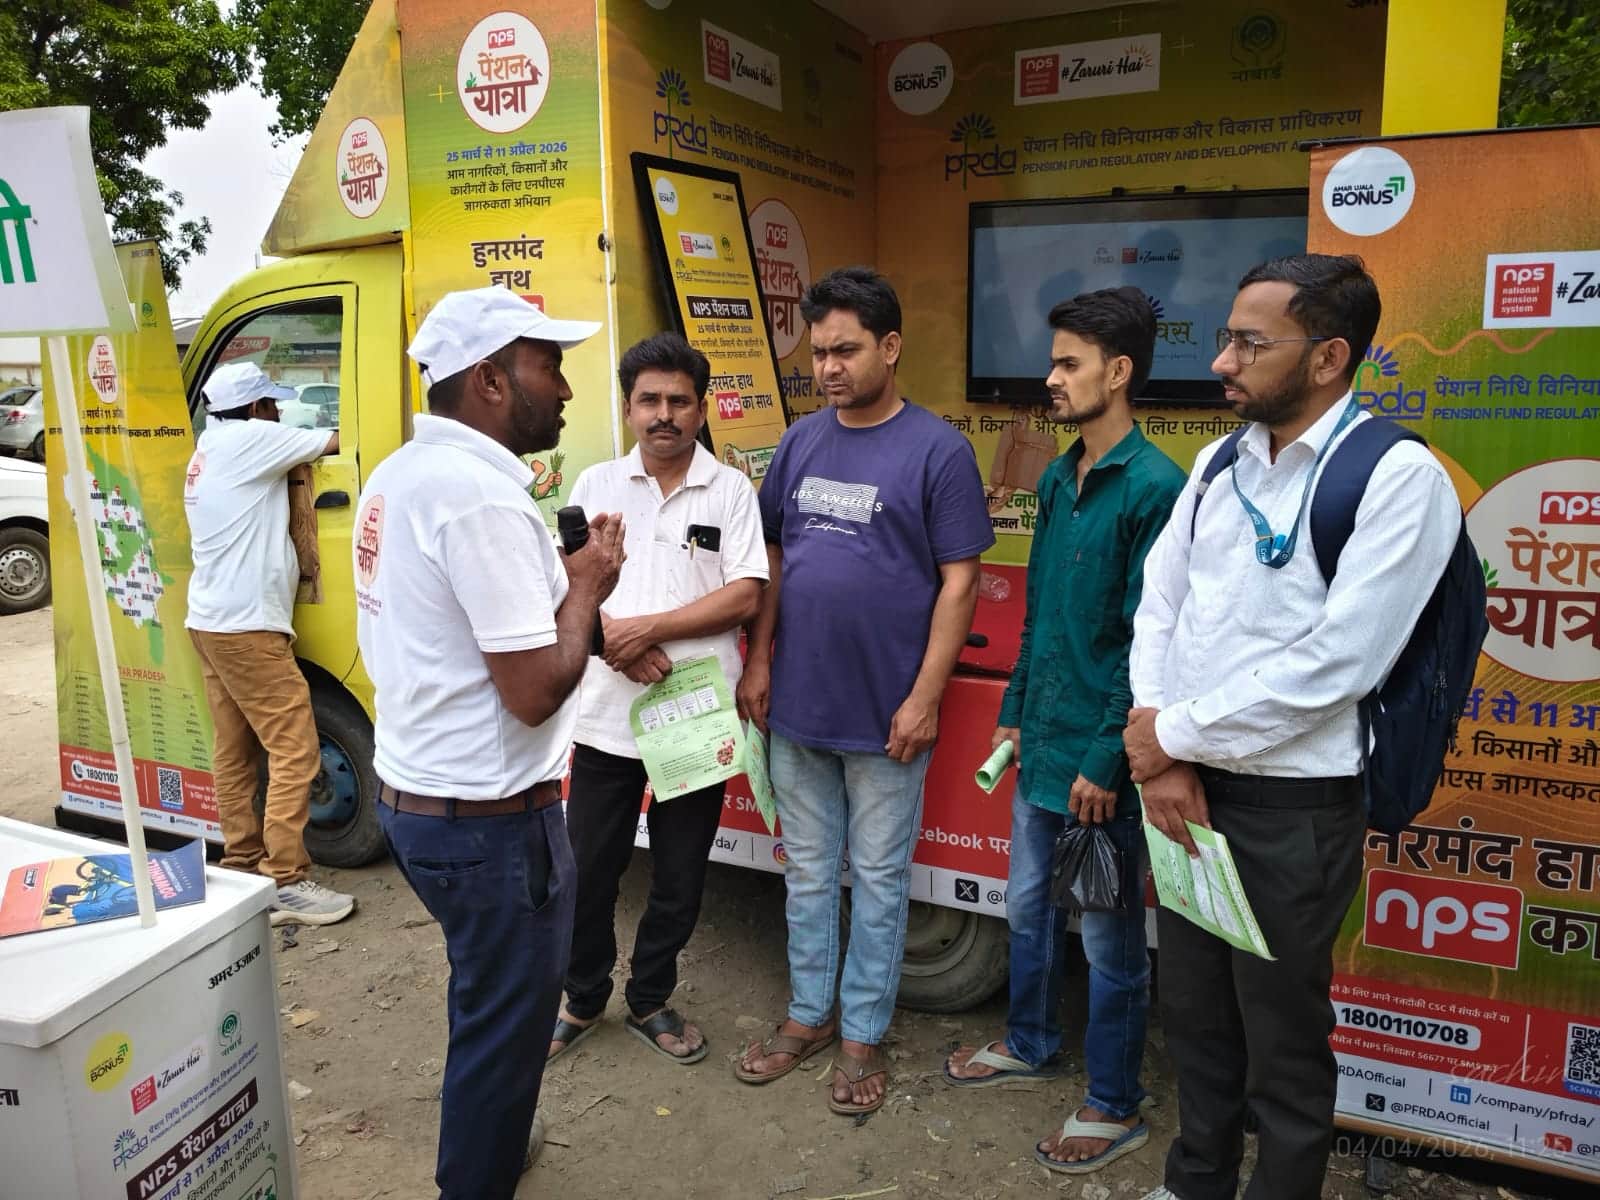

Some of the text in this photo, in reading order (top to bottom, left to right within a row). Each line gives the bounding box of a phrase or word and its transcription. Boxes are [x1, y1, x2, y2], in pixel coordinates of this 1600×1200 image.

[489, 30, 514, 46] nps
[477, 52, 527, 82] पेंशन
[1025, 58, 1054, 72] nps
[1061, 58, 1114, 84] #Zaruri
[1117, 57, 1144, 74] Hai
[895, 76, 938, 92] BONUS
[465, 80, 539, 117] यात्रा
[1064, 130, 1097, 152] निधि
[1183, 119, 1215, 140] और
[1219, 116, 1276, 137] विकास
[1279, 109, 1363, 132] प्राधिकरण
[447, 152, 459, 162] 25
[462, 145, 481, 161] मार्च
[484, 145, 493, 158] से
[496, 147, 506, 157] 11
[539, 142, 568, 154] 2026
[1022, 162, 1067, 174] PENSION
[1069, 158, 1098, 169] FUND
[1100, 150, 1172, 168] REGULATORY
[1174, 149, 1199, 161] AND
[1201, 141, 1289, 159] DEVELOPMENT
[347, 151, 376, 177] पेंशन
[447, 158, 568, 180] आम नागरिकों, किसानों और
[342, 173, 382, 204] यात्रा
[450, 176, 565, 196] कारीगरों के लिए एनपीएस
[513, 194, 552, 208] अभियान
[1331, 189, 1394, 207] BONUS
[765, 224, 788, 242] nps
[1503, 267, 1545, 284] nps
[1501, 296, 1538, 305] pension
[1502, 286, 1540, 295] national
[692, 299, 748, 317] NPS पेंशन यात्रा
[1501, 305, 1534, 314] system
[736, 374, 754, 391] हाथ
[1434, 376, 1483, 397] पेंशन
[1487, 374, 1532, 397] निधि
[718, 393, 774, 417] nps का साथ
[1433, 408, 1491, 419] PENSION
[1494, 408, 1532, 419] FUND
[154, 426, 185, 438] अभियान
[1145, 415, 1178, 436] लिए
[791, 489, 883, 513] LOS ANGELES
[1490, 690, 1520, 724] से
[1528, 702, 1557, 727] 11
[1472, 730, 1562, 764] किसानों
[86, 769, 118, 783] 18001107
[1375, 888, 1510, 949] nps
[207, 944, 261, 989] अमर उजाला
[1352, 986, 1370, 998] लिए
[1428, 1003, 1446, 1013] CSC
[1341, 1006, 1469, 1046] 1800110708
[91, 1055, 126, 1083] BONUS
[1338, 1065, 1407, 1089] RDAOfficial
[1474, 1093, 1596, 1129] /company/pfrda/
[1391, 1101, 1491, 1131] @PFRDAOfficial
[139, 1093, 251, 1198] NPS पेंशन यात्रा
[183, 1172, 192, 1189] से
[232, 1118, 254, 1145] 2026
[219, 1158, 234, 1177] और
